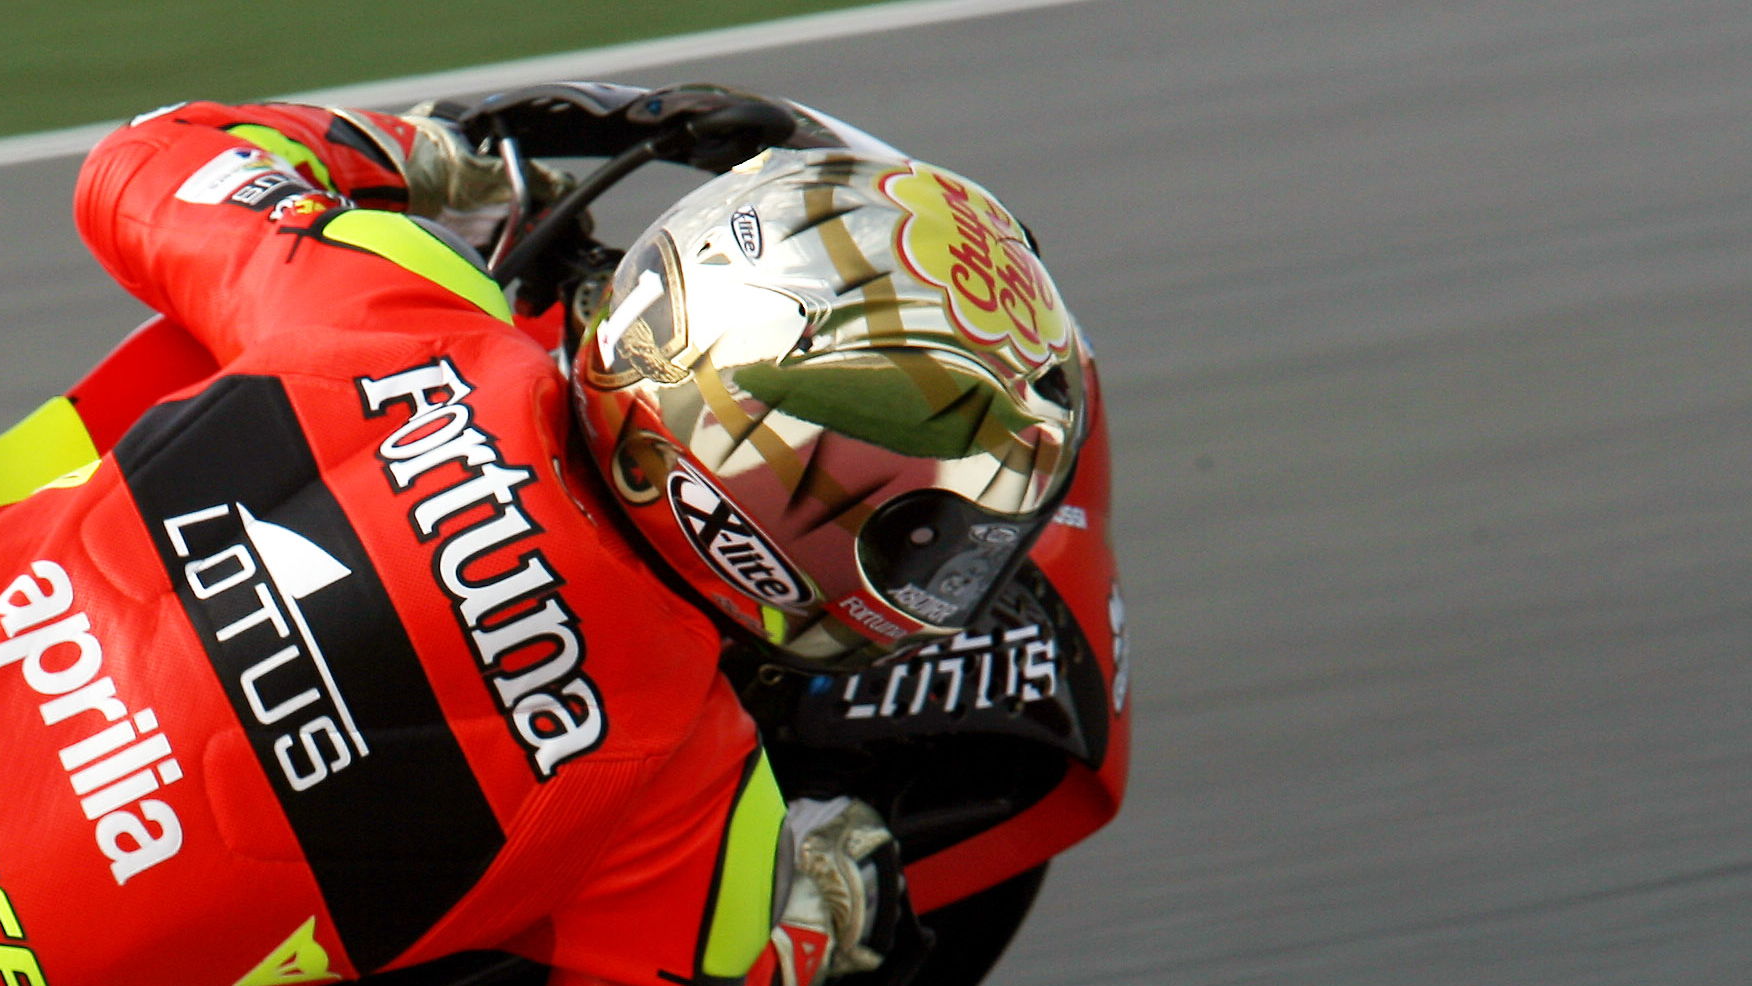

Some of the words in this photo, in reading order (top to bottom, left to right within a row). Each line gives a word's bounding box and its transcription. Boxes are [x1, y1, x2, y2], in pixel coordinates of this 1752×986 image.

[163, 502, 352, 793] LOTUS
[356, 356, 608, 781] Fortuna
[675, 497, 790, 598] X-lite
